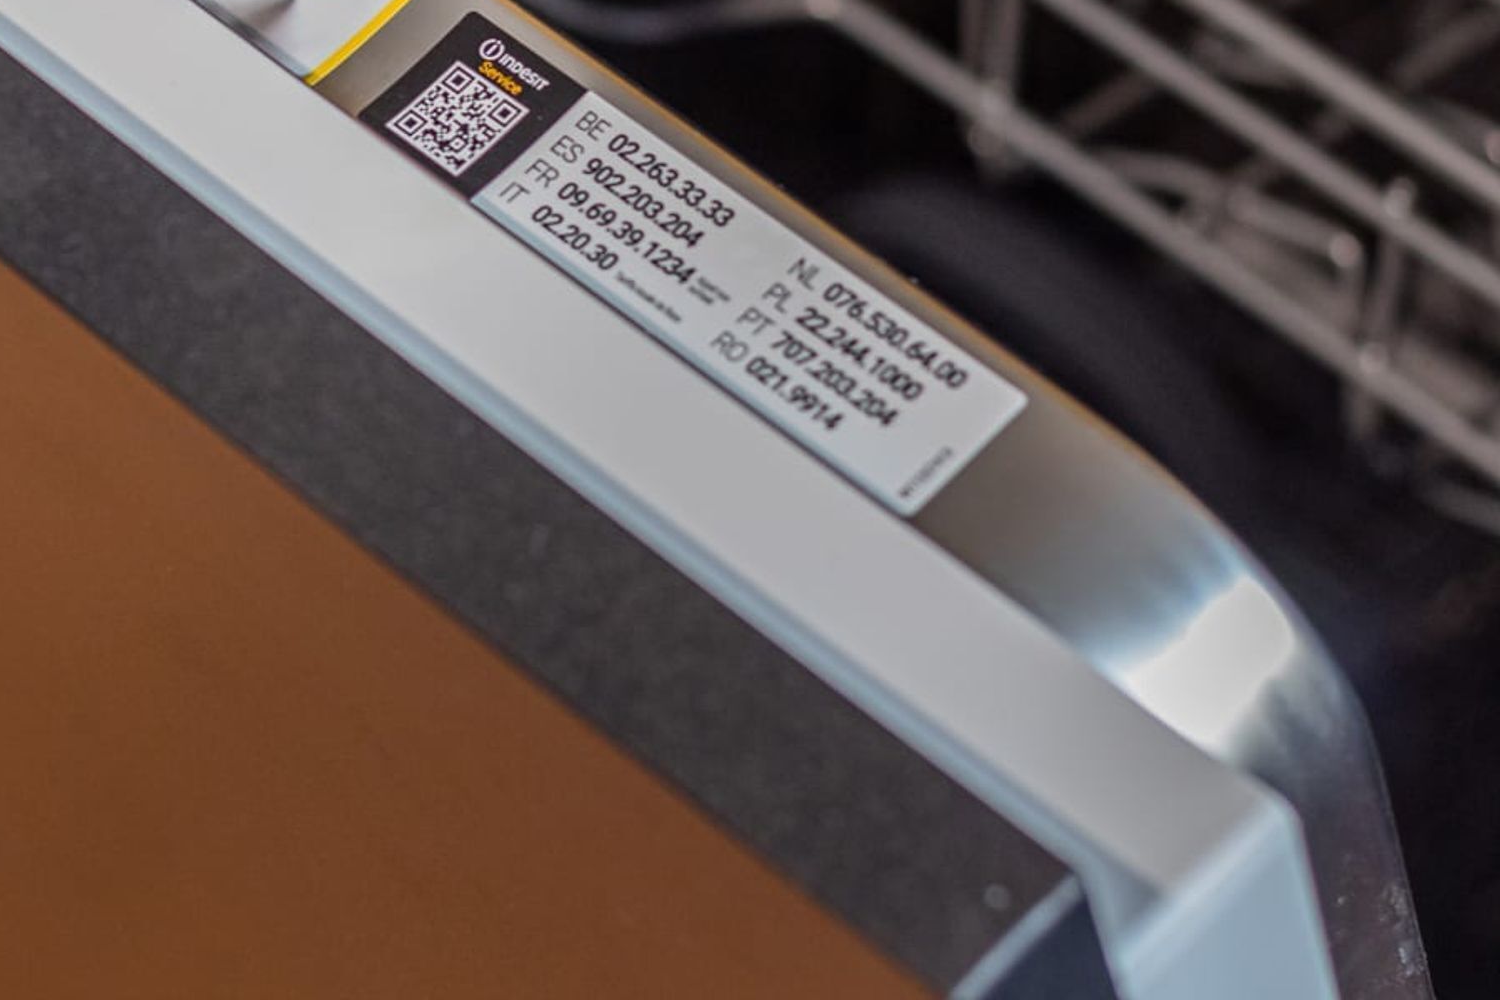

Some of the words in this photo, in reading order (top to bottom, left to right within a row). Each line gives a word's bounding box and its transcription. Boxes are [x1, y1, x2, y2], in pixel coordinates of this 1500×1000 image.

[478, 60, 523, 96] Service
[499, 182, 531, 204] IT
[531, 205, 620, 272] 02.20.30
[524, 158, 560, 189] FR
[557, 182, 697, 285] 09.69.39.1234
[550, 135, 585, 164] ES
[582, 157, 705, 249] 902.203.204
[575, 110, 613, 141] BE
[608, 133, 736, 228] 02.263.33.33
[710, 331, 751, 363] RO
[745, 356, 844, 431] 021.9914
[736, 307, 776, 336] PT
[772, 331, 898, 427] 707.203.204
[761, 282, 793, 315] PL
[795, 306, 924, 402] 22.244.1000
[787, 258, 821, 291] NL
[823, 283, 968, 389] 076.530.64.00
